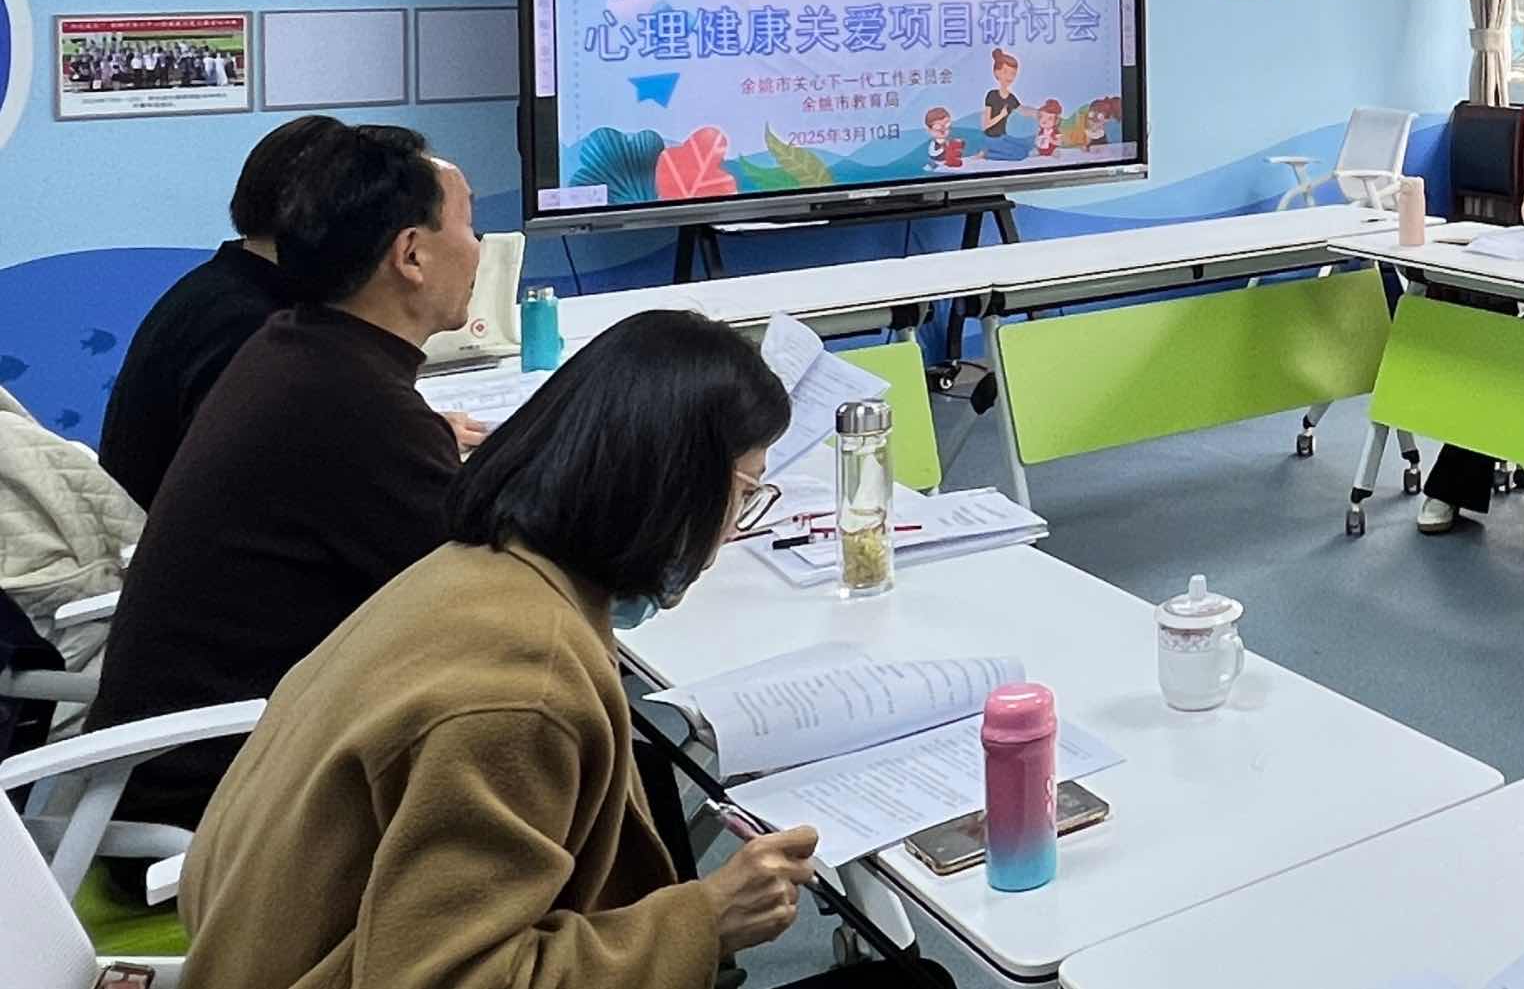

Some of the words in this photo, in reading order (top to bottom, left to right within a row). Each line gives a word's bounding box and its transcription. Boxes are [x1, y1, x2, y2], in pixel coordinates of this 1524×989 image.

[740, 68, 953, 95] 余姚市关心下一代工作委员会
[802, 91, 900, 113] 余姚市教育局
[788, 123, 900, 146] 2025年3月10日
